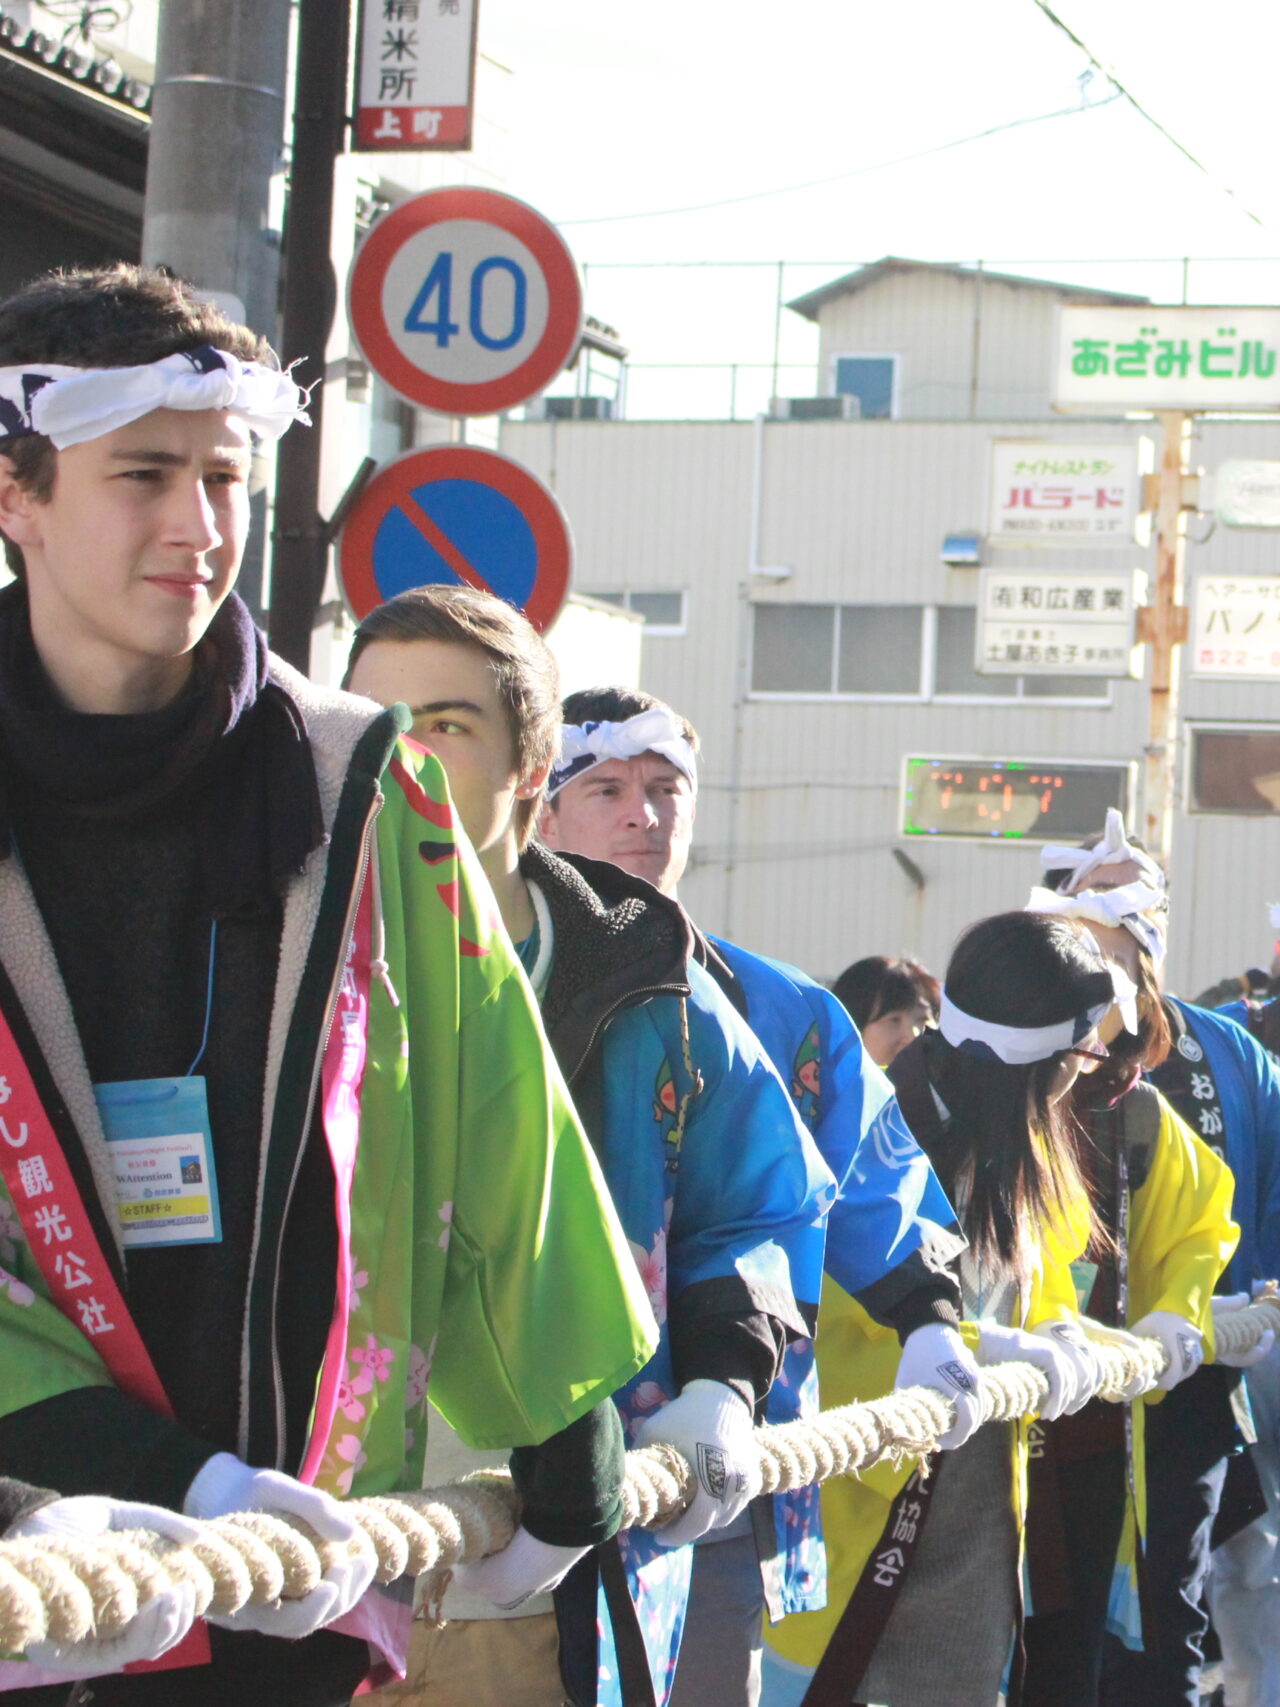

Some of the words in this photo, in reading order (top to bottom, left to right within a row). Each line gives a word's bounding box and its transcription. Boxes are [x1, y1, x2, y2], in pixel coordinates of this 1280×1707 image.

[379, 0, 419, 101] 精米所
[373, 109, 443, 140] 上町
[404, 251, 528, 353] 40
[1071, 326, 1277, 379] あざみビル
